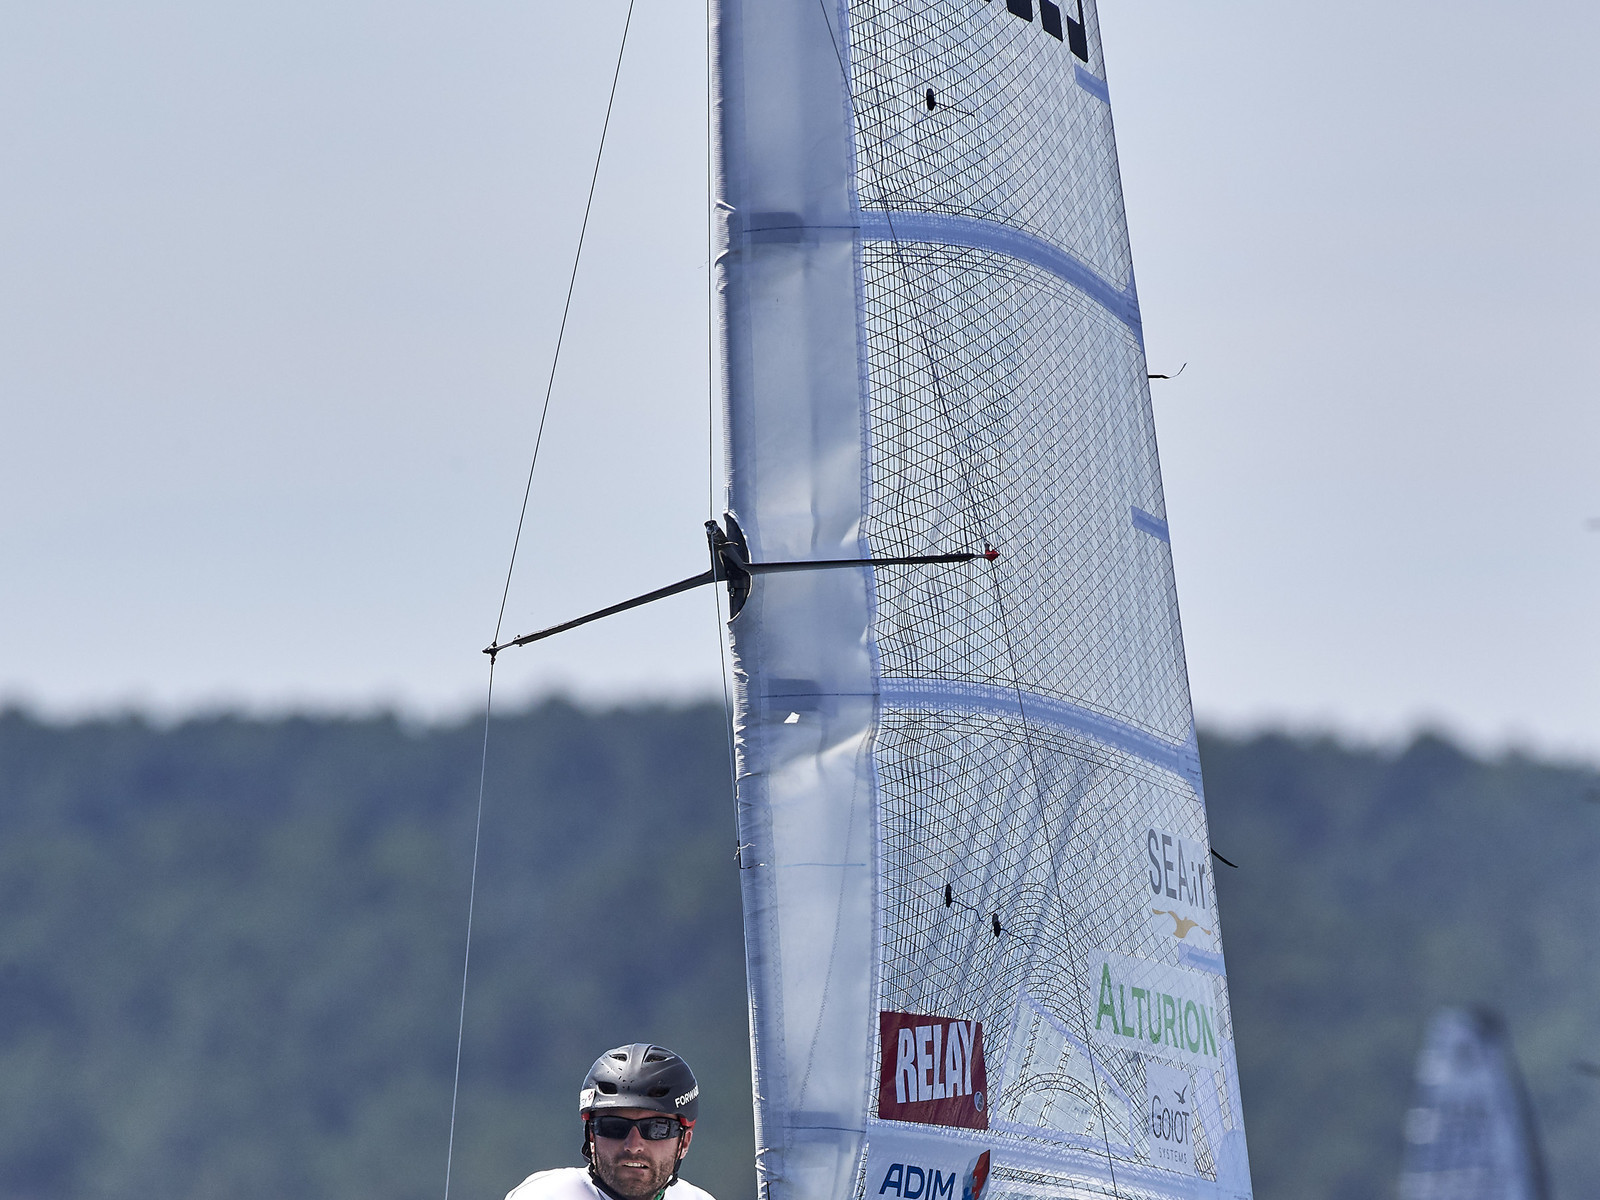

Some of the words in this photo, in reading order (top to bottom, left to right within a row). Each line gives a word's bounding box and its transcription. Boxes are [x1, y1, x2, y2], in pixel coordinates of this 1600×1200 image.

[1094, 962, 1218, 1058] ALTURION
[894, 1020, 977, 1104] RELAY
[1151, 1094, 1190, 1146] GOIOT
[1158, 1146, 1188, 1165] SYSTEMS
